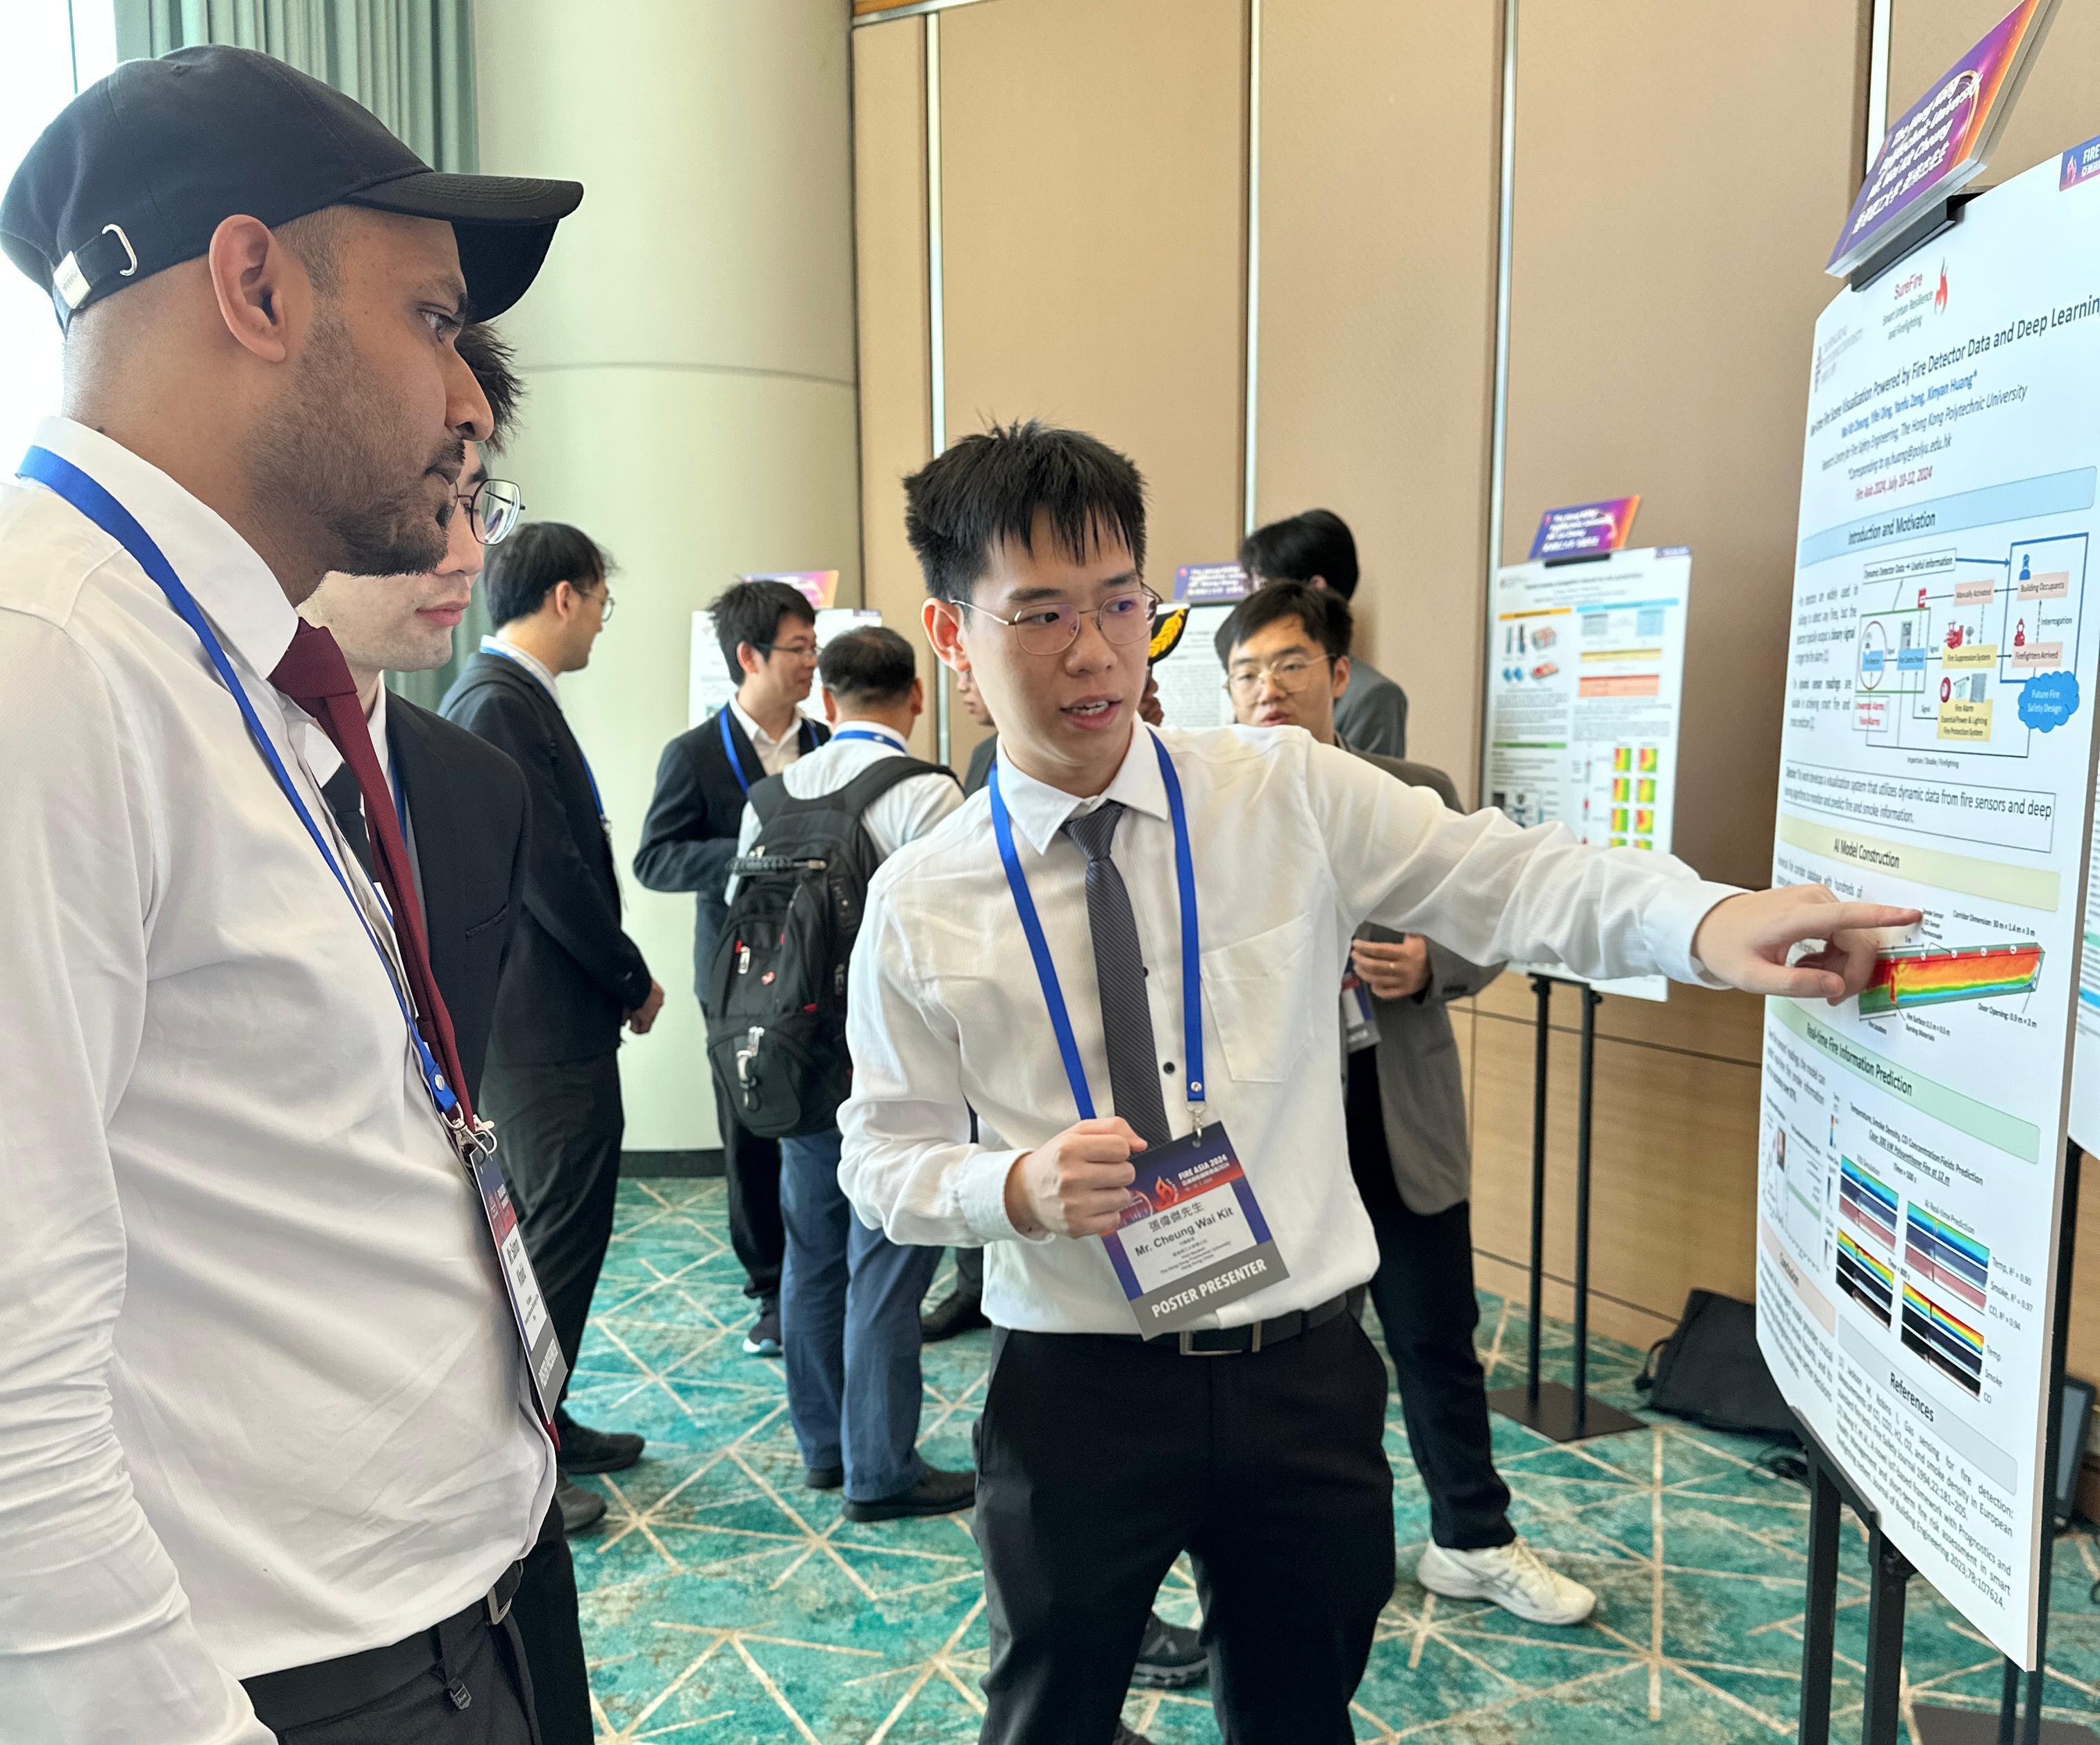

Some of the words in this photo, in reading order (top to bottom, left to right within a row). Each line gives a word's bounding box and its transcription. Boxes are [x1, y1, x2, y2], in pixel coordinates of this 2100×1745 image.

[1873, 367, 1901, 396] Powered
[1902, 365, 1910, 387] by
[1912, 361, 1926, 380] Fire
[1928, 345, 1966, 373] Detector
[1967, 335, 1990, 357] Data
[1993, 322, 2015, 348] and
[2017, 315, 2048, 337] Deep
[1927, 383, 1949, 401] Xinyan
[1911, 417, 1927, 433] Hong
[1928, 410, 1944, 427] Kong
[1944, 397, 1985, 422] Polytechnic
[1986, 384, 2028, 408] University
[1848, 523, 1881, 545] Introduction
[1881, 518, 1895, 537] and
[1896, 511, 1936, 534] Motivation
[2020, 584, 2039, 594] Building
[2040, 582, 2065, 592] Occupants
[2015, 651, 2040, 662] Firefighters
[2041, 650, 2059, 660] Arrived
[2027, 703, 2044, 715] Safety
[2044, 703, 2062, 715] Design
[2031, 689, 2049, 699] Future
[2049, 690, 2060, 699] Fire
[1851, 780, 1867, 794] system
[1867, 780, 1878, 794] that
[1879, 782, 1897, 797] utilizes
[1898, 783, 1924, 802] dynamic
[1924, 787, 1940, 803] data
[1941, 789, 1958, 806] from
[1960, 792, 1974, 808] fire
[1974, 796, 2006, 812] sensors
[2008, 798, 2026, 814] and
[2027, 799, 2051, 821] deep
[1853, 801, 1862, 813] and
[1862, 802, 1879, 817] smoke
[1880, 803, 1914, 823] information.
[1833, 837, 1840, 853] AI
[1840, 839, 1858, 858] Model
[1859, 844, 1900, 869] Construction
[1856, 885, 1863, 898] of
[1978, 1002, 1989, 1012] Door
[1990, 1006, 2009, 1021] Opening:
[2027, 1018, 2031, 1027] 2
[1806, 1021, 1828, 1049] Real-time
[1828, 1036, 1839, 1055] Fire
[1839, 1043, 1874, 1076] Information
[1875, 1063, 1912, 1096] Prediction
[1178, 1168, 1194, 1180] FIRE
[1193, 1161, 1210, 1174] ASIA
[1208, 1153, 1228, 1167] 2024
[1872, 1117, 1885, 1132] Smoke
[1885, 1124, 1901, 1143] Density,
[1901, 1133, 1908, 1145] CO
[1908, 1137, 1940, 1162] Concentration
[1940, 1155, 1955, 1171] Fields
[1956, 1164, 1983, 1186] Prediction
[1894, 1162, 1903, 1174] Time
[1922, 1161, 1931, 1172] Fire
[1938, 1171, 1944, 1181] 12
[1944, 1176, 1950, 1184] m
[1134, 1244, 1153, 1256] Mr.
[1153, 1225, 1195, 1248] Cheung
[1194, 1213, 1216, 1229] Wai
[1216, 1207, 1234, 1221] Kit
[1924, 1199, 1930, 1208] AI
[1930, 1201, 1951, 1221] Real-time
[1950, 1214, 1976, 1235] Prediction
[1888, 1257, 1897, 1271] Time
[1992, 1256, 2008, 1275] Temp,
[2019, 1273, 2032, 1287] 0.90
[1151, 1288, 1199, 1318] POSTER
[1198, 1258, 1267, 1297] PRESENTER
[1990, 1280, 2010, 1301] Smoke,
[2021, 1299, 2033, 1312] 0.97
[1988, 1304, 1999, 1319] CO,
[2008, 1317, 2022, 1330] 0.94
[1986, 1344, 2001, 1362] Temp
[1984, 1368, 2003, 1388] Smoke
[1890, 1372, 1934, 1422] References
[1983, 1392, 1992, 1404] CO
[1873, 1424, 1883, 1442] Fire
[1883, 1433, 1897, 1457] Safety
[1897, 1448, 1916, 1473] Journal
[1867, 1403, 1873, 1413] of
[1873, 1408, 1881, 1425] CO,
[1881, 1416, 1894, 1437] CO2,
[1903, 1437, 1914, 1455] O2,
[1915, 1448, 1926, 1464] and
[1926, 1460, 1945, 1482] smoke
[1946, 1476, 1969, 1505] density
[1971, 1494, 1977, 1509] in
[1979, 1503, 2012, 1538] European
[1904, 1420, 1915, 1437] Gas
[1919, 1435, 1940, 1462] sensing
[1946, 1455, 1955, 1471] for
[1960, 1467, 1972, 1487] fire
[1978, 1483, 2014, 1519] detection:
[1878, 1467, 1888, 1483] and
[1889, 1478, 1916, 1510] short-term
[1917, 1503, 1928, 1522] fire
[1929, 1517, 1940, 1533] risk
[1942, 1529, 1978, 1568] assessment
[1980, 1560, 1988, 1576] in
[1990, 1571, 2011, 1597] smart
[1889, 1495, 1896, 1506] of
[1895, 1499, 1916, 1530] Building
[1916, 1520, 1950, 1563] Engineering
[1912, 1481, 1942, 1517] framework
[1944, 1513, 1958, 1531] with
[1958, 1523, 1996, 1564] Prognostics
[1997, 1559, 2012, 1577] and
